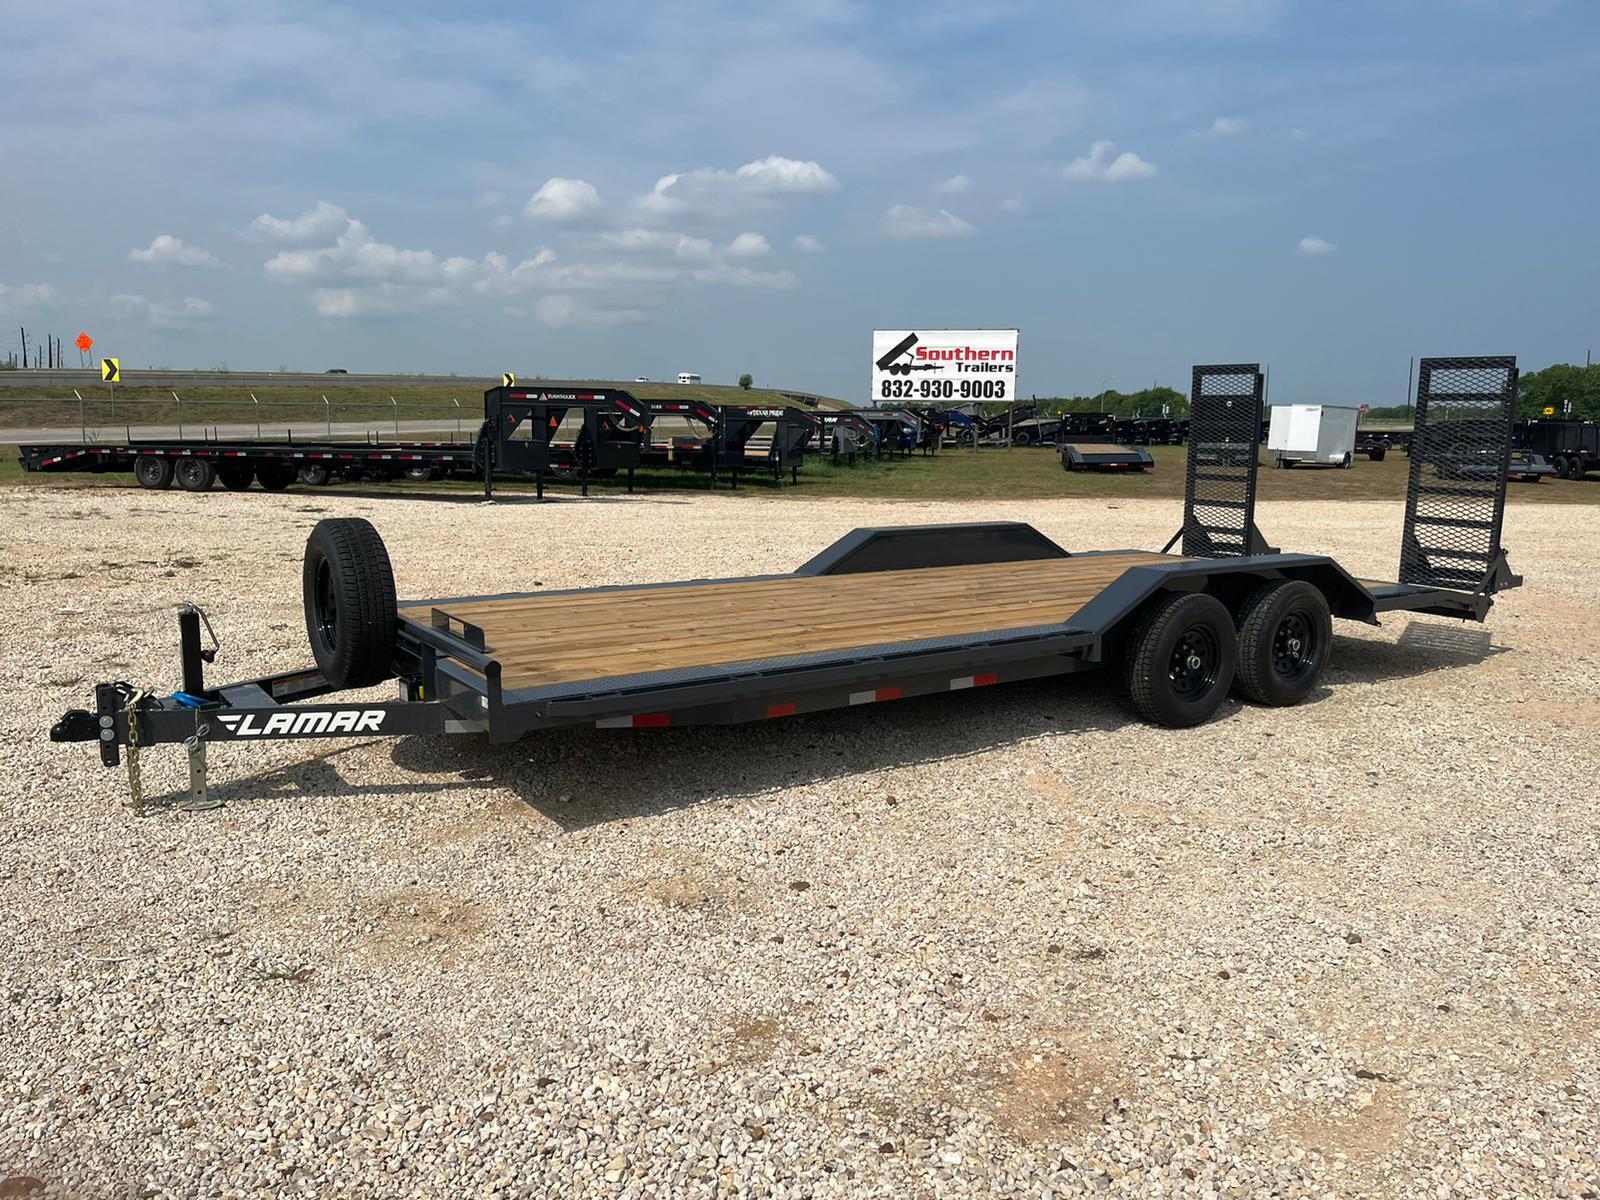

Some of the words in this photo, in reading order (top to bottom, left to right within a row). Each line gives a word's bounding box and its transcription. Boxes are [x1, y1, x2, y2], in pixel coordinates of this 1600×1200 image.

[916, 346, 1014, 361] Southern
[955, 362, 1014, 373] Trailers
[881, 379, 1006, 399] 832-930-9003
[235, 709, 387, 736] LAMAR
